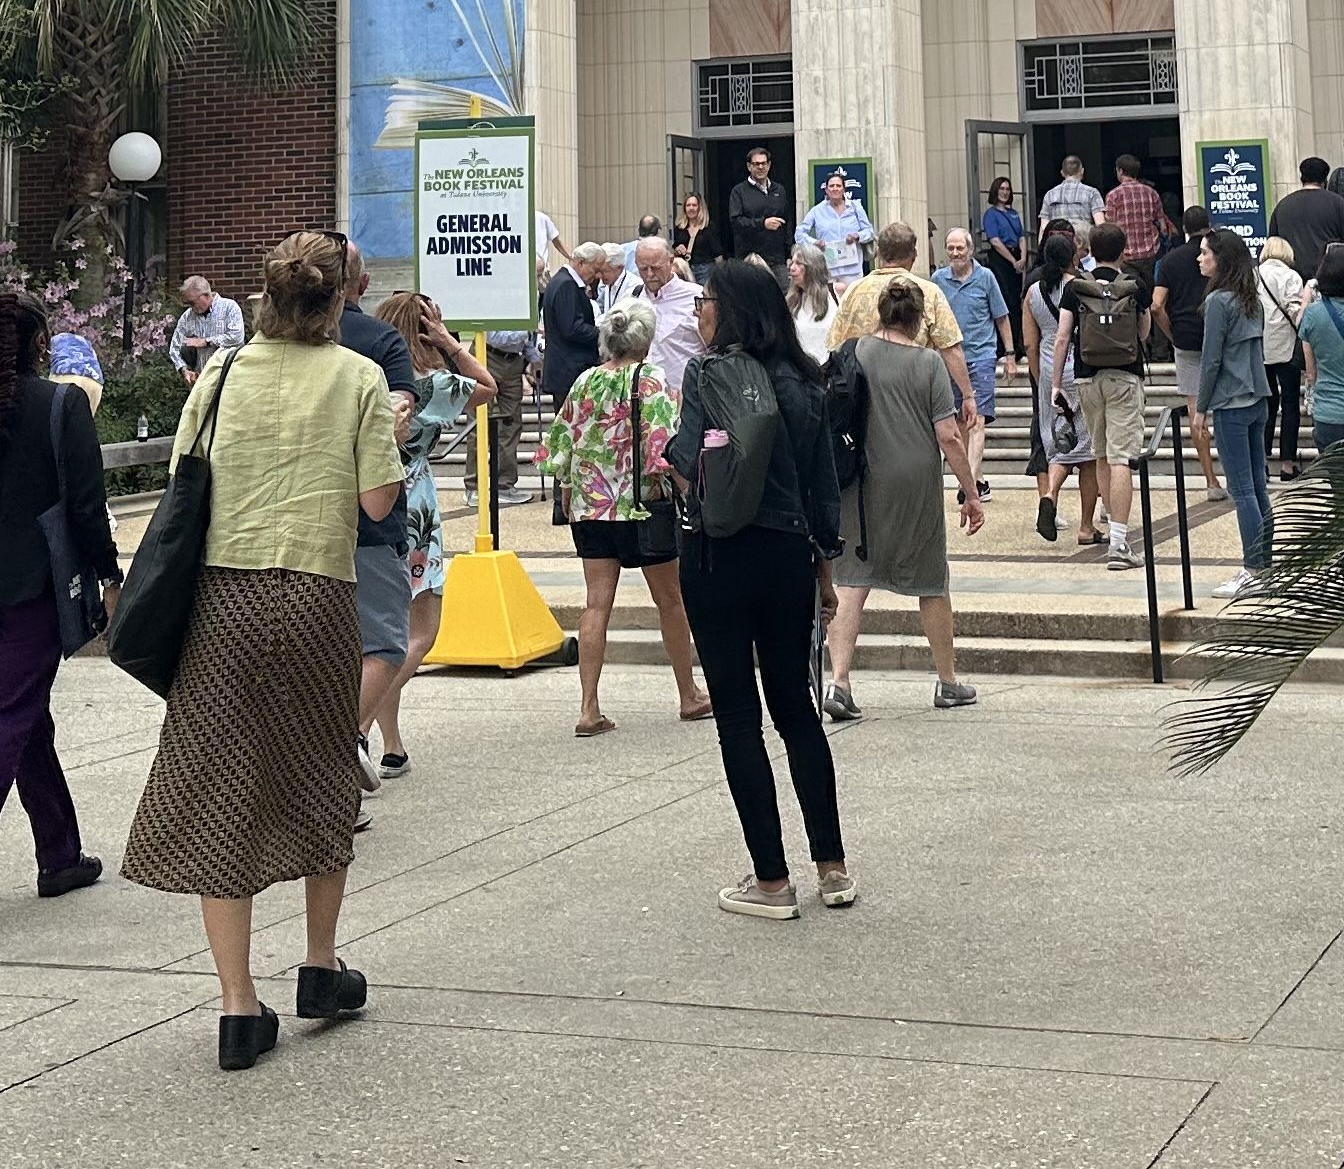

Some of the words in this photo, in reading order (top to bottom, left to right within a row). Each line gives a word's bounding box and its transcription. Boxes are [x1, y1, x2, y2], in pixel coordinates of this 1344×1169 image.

[435, 169, 464, 180] NEW
[467, 167, 524, 179] ORLEANS
[1222, 175, 1247, 184] NEW
[424, 180, 461, 191] BOOK
[464, 178, 524, 190] FESTIVAL
[1211, 183, 1258, 194] ORLEANS
[1219, 191, 1250, 201] BOOK
[1210, 199, 1260, 210] FESTIVAL
[437, 213, 512, 234] GENERAL
[426, 235, 522, 255] ADMISSION
[456, 257, 492, 276] LINE
